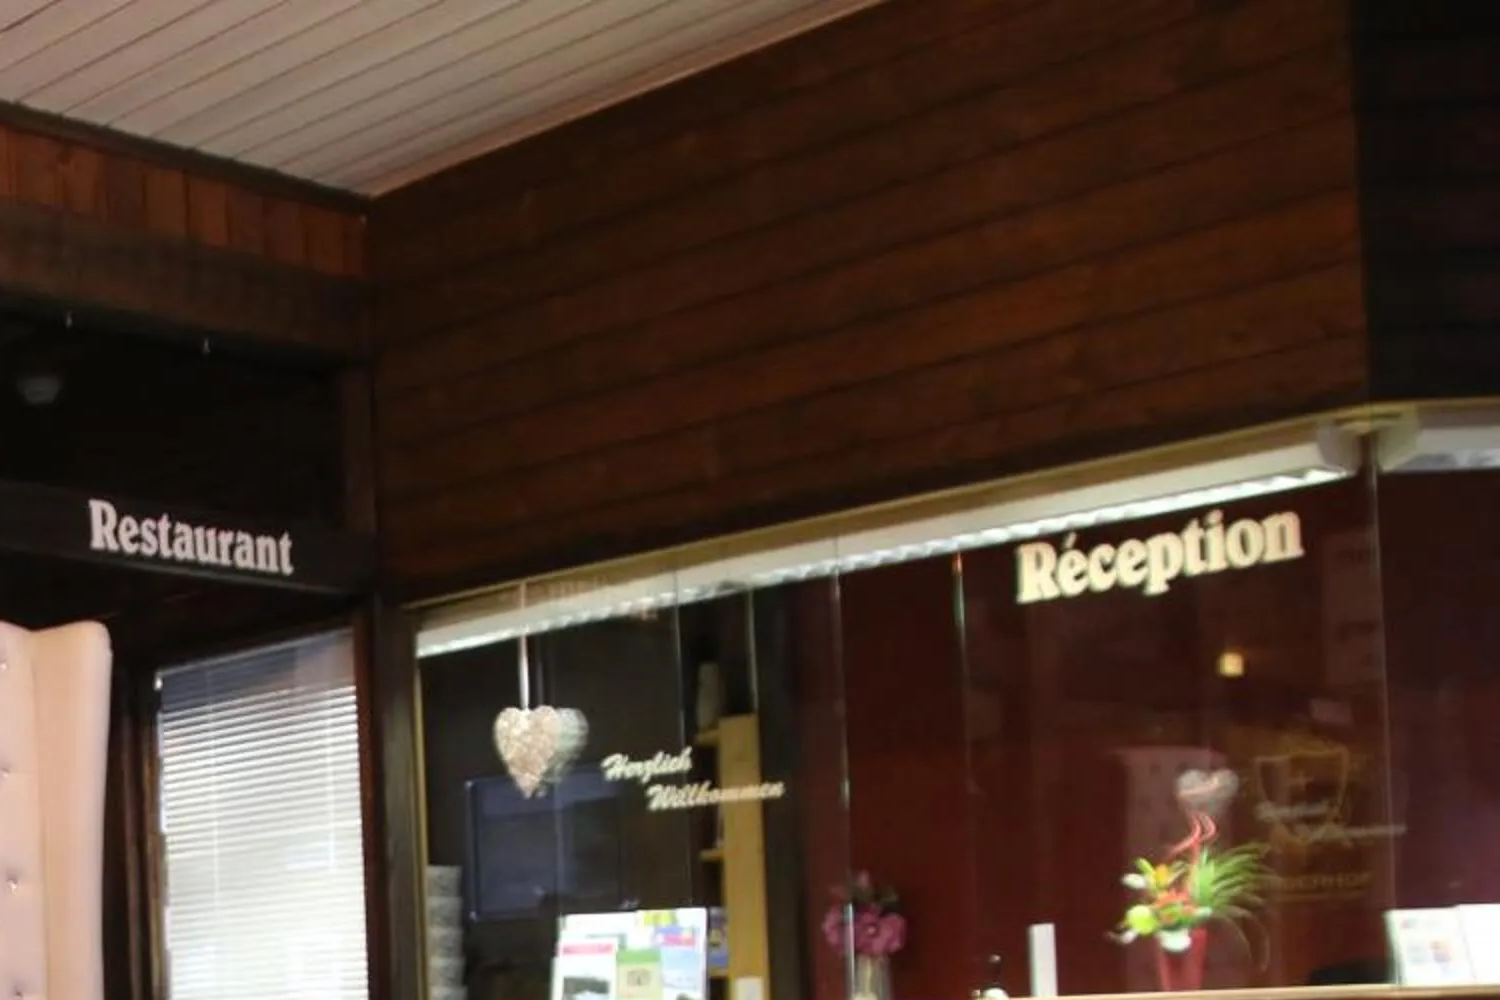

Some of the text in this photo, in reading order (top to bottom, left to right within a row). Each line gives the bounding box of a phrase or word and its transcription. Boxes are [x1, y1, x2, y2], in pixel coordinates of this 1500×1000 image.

[88, 499, 294, 576] Restaurant
[1016, 509, 1305, 604] Réception
[602, 746, 693, 783] Herzlich
